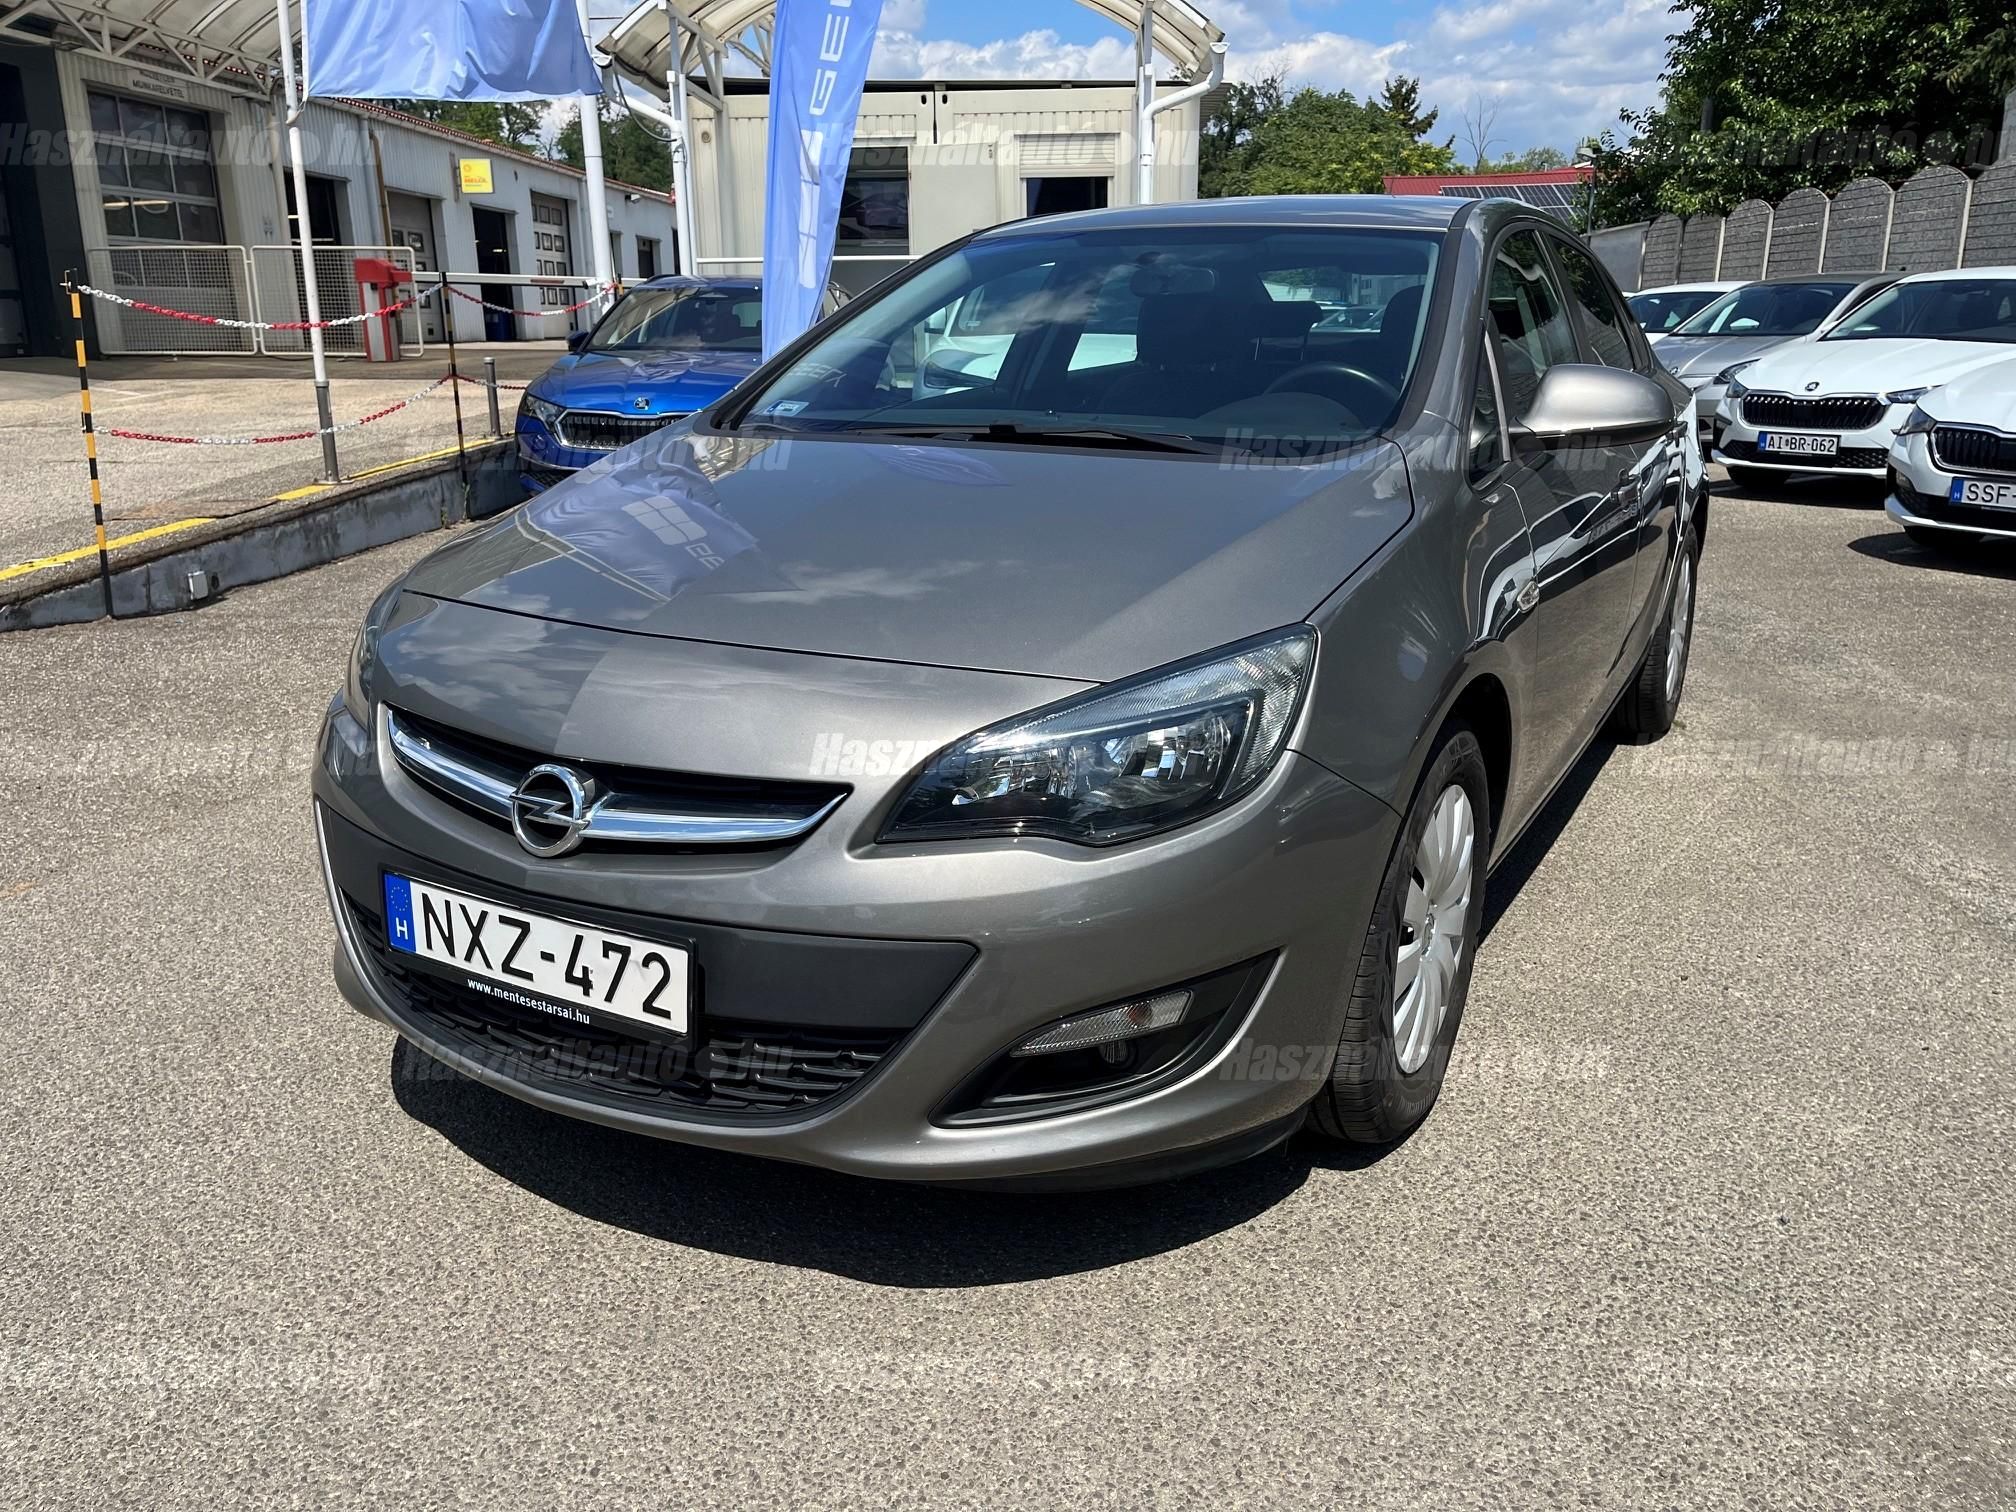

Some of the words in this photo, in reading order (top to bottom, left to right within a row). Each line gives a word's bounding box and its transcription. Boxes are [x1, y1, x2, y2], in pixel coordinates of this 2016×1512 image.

[395, 916, 409, 941] H
[421, 892, 672, 1020] NXZ-472
[467, 977, 591, 1025] www.mentesestarsai.hu
